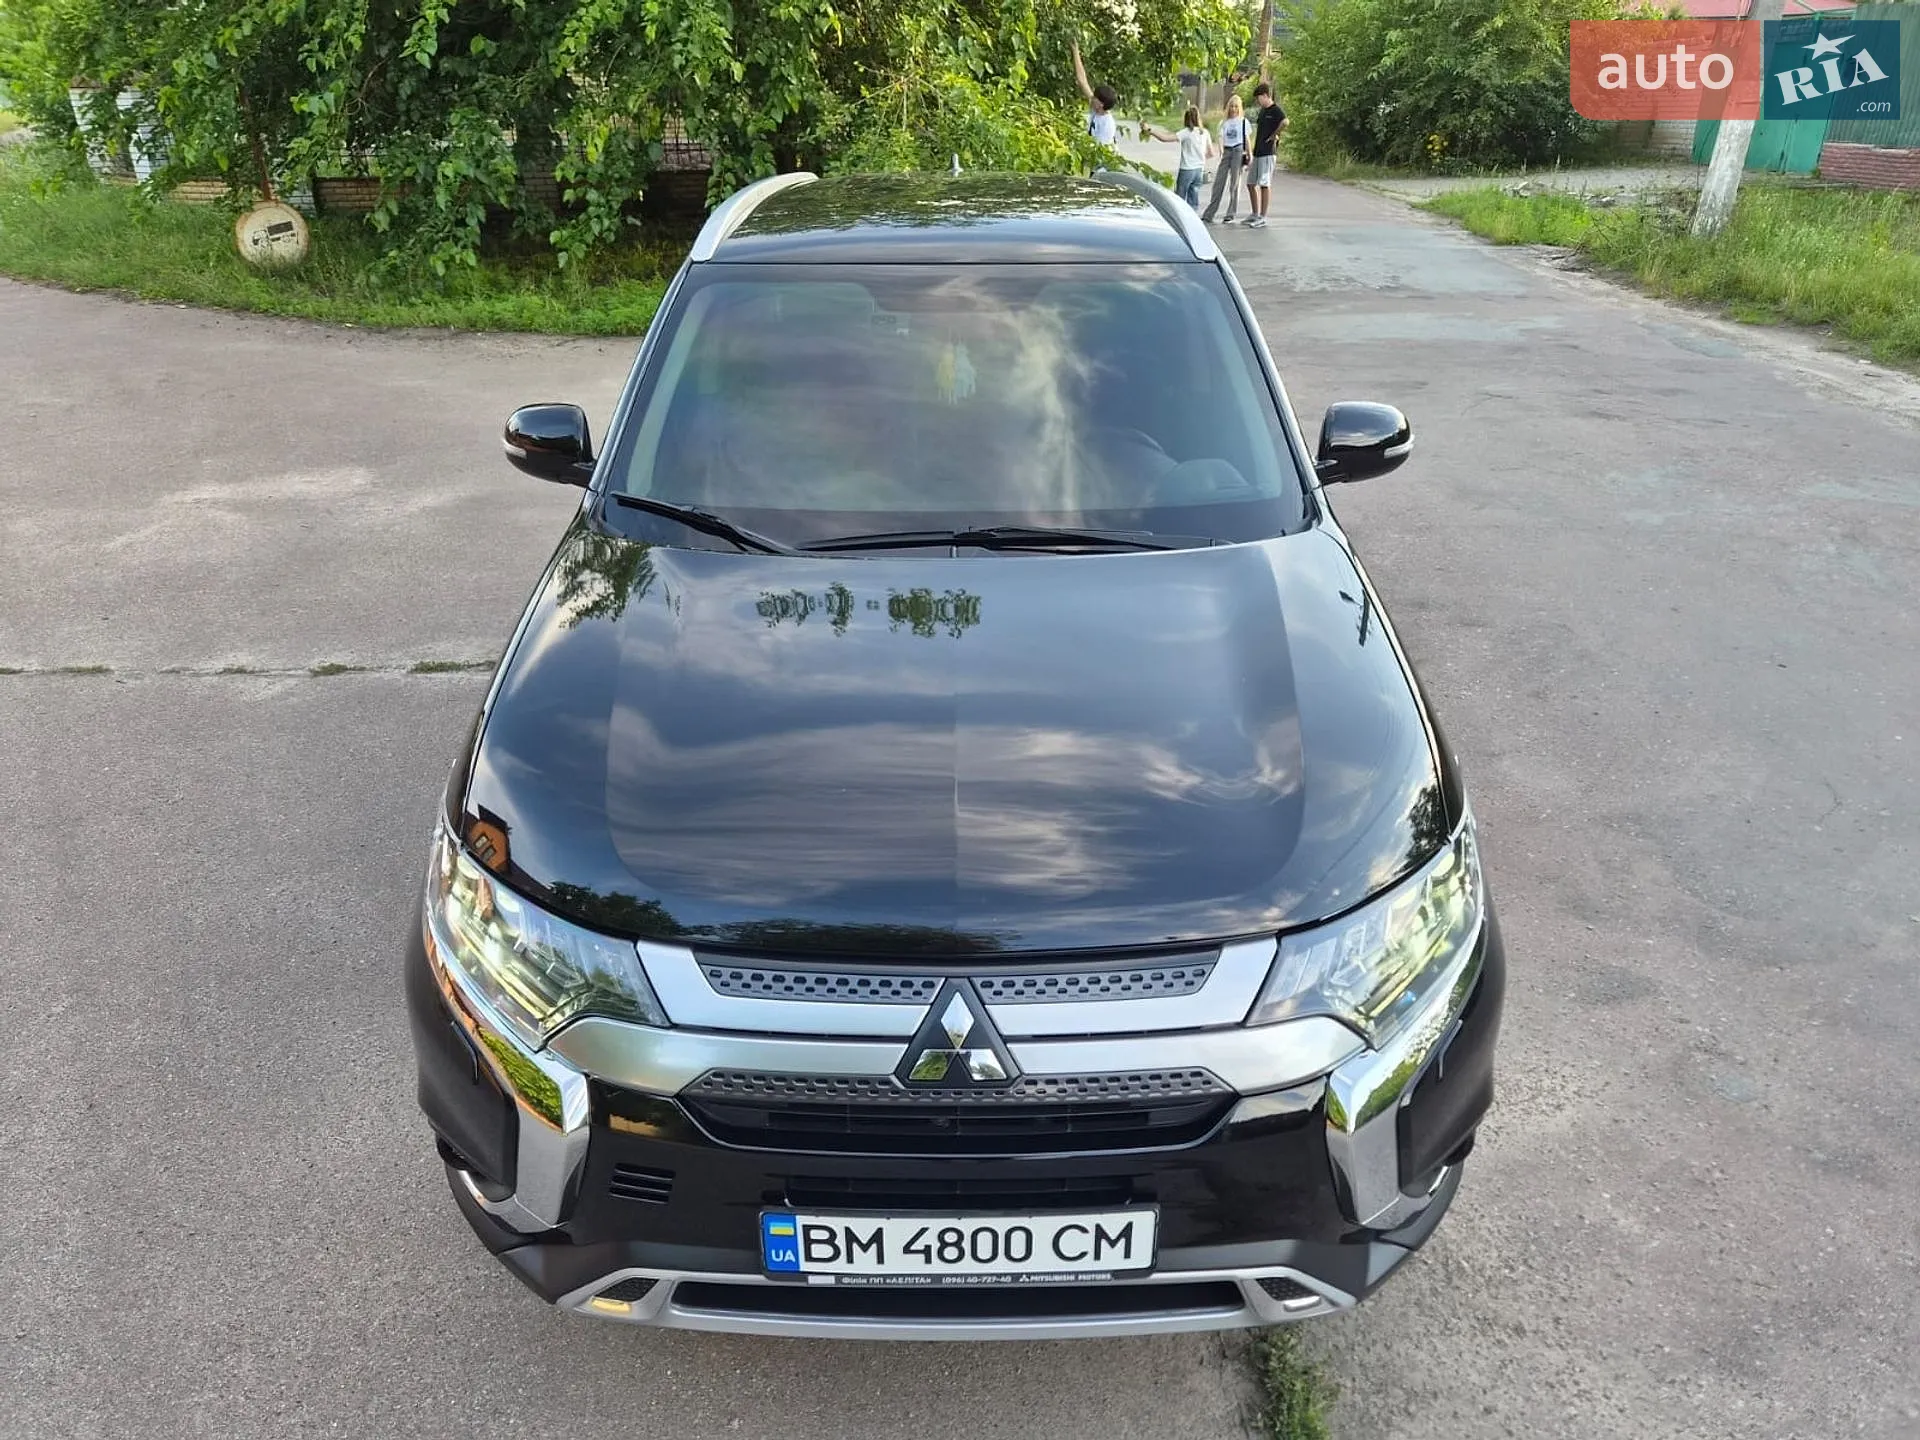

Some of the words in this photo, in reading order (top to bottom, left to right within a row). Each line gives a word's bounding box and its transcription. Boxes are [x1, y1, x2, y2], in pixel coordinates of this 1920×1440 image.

[771, 1249, 796, 1263] UA
[801, 1224, 885, 1264] BM
[902, 1226, 1034, 1265] 4800
[1052, 1221, 1134, 1262] CM
